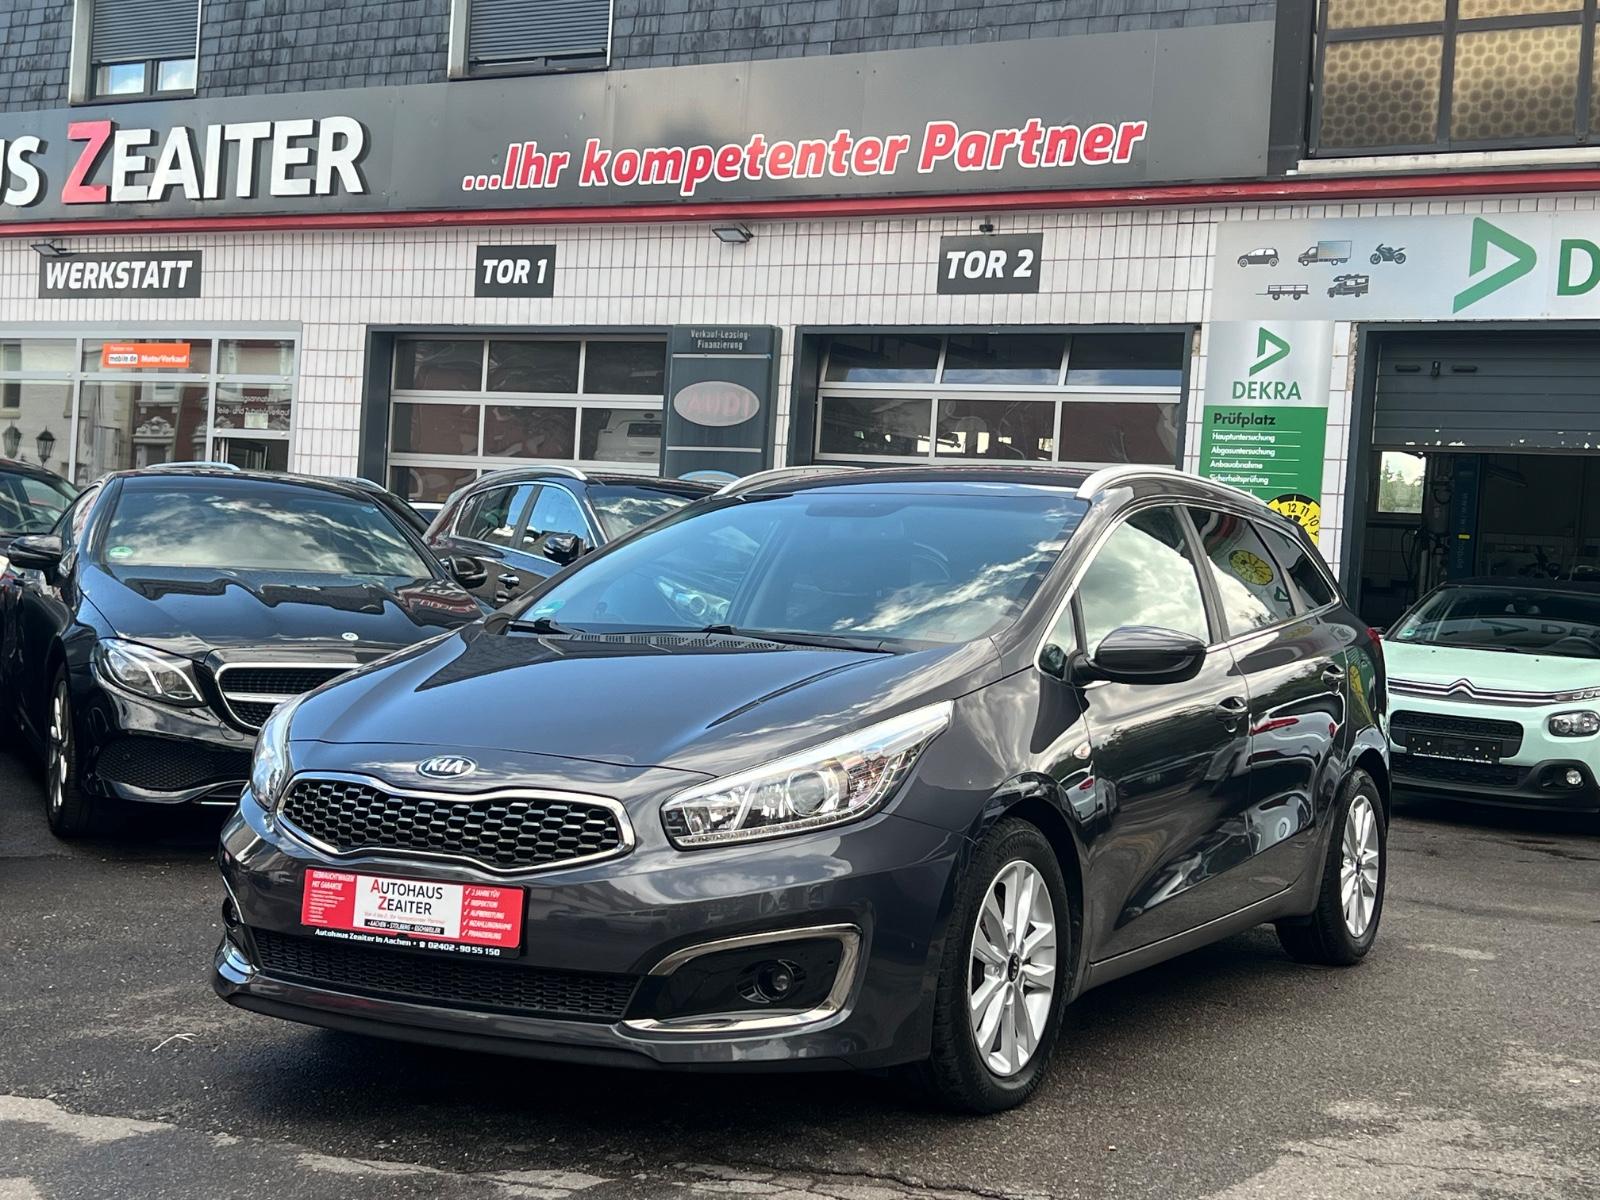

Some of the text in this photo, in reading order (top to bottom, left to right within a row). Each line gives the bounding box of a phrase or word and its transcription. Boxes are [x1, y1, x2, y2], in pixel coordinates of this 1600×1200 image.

[0, 116, 365, 207] S ZEAITER
[578, 129, 911, 197] kompetenter
[917, 117, 1147, 173] Partner
[483, 259, 548, 284] TOR 1
[946, 249, 1034, 279] TOR 2
[46, 260, 193, 289] WERKSTATT
[697, 340, 743, 351] Finanzierung
[1232, 381, 1302, 400] DEKRA
[1213, 412, 1276, 428] Prüfplatz
[1212, 432, 1275, 443] Hauptuntersuchung
[1211, 446, 1275, 457] Abgasuntersuchung
[1210, 460, 1263, 469] Anbauabnahme
[1209, 474, 1269, 485] Sicherheitsprüfung
[1288, 503, 1297, 513] 12
[1300, 505, 1310, 517] 11
[1308, 514, 1320, 527] 10
[424, 758, 464, 773] KIA
[370, 879, 443, 899] AUTOHAUS
[378, 896, 432, 915] ZEAITER
[314, 928, 348, 939] Autohaus
[349, 932, 374, 943] Zeaiter
[383, 936, 411, 947] Aachen
[472, 946, 483, 954] 55
[484, 947, 500, 956] 150
